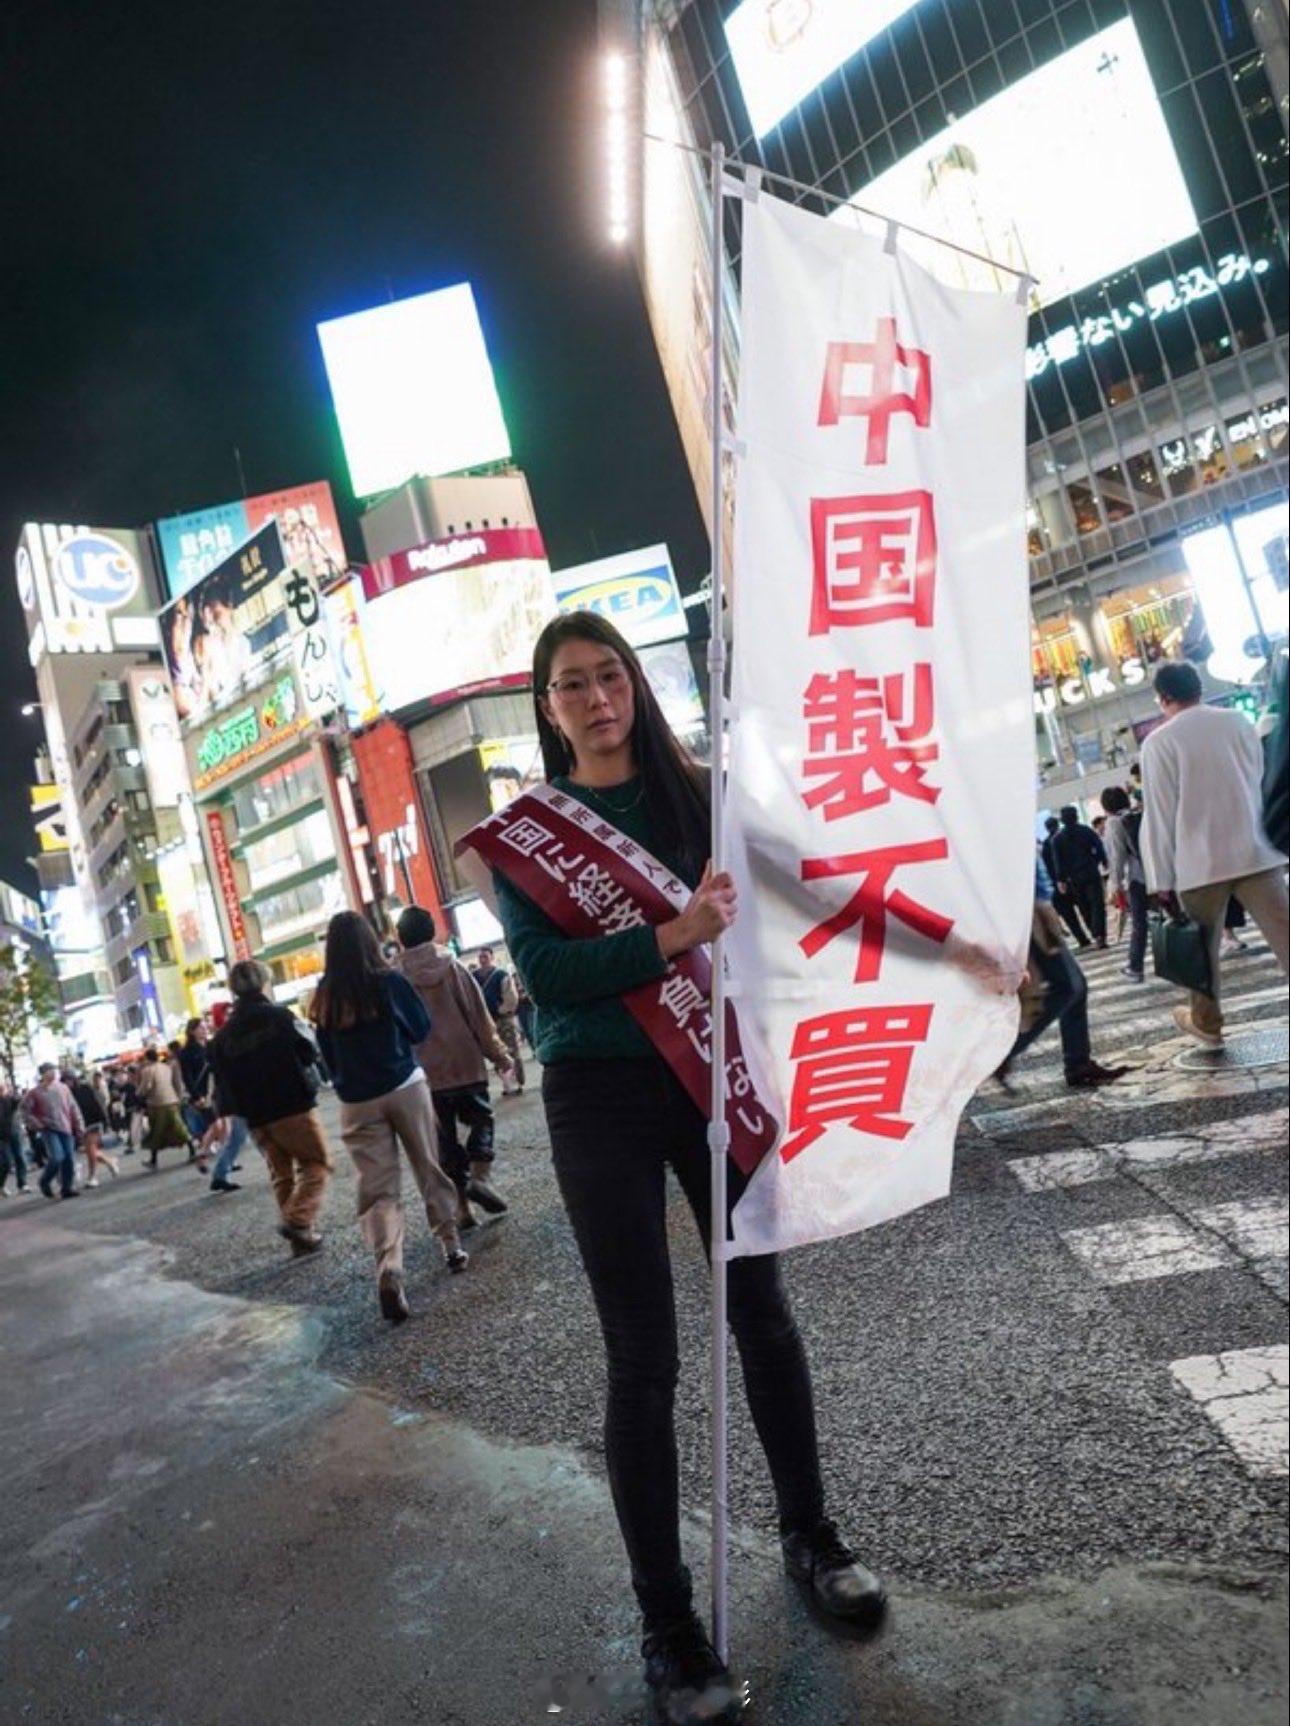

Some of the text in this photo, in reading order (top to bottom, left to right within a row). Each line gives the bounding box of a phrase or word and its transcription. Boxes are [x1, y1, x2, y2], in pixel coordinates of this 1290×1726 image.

[779, 316, 955, 1164] 中国製不買
